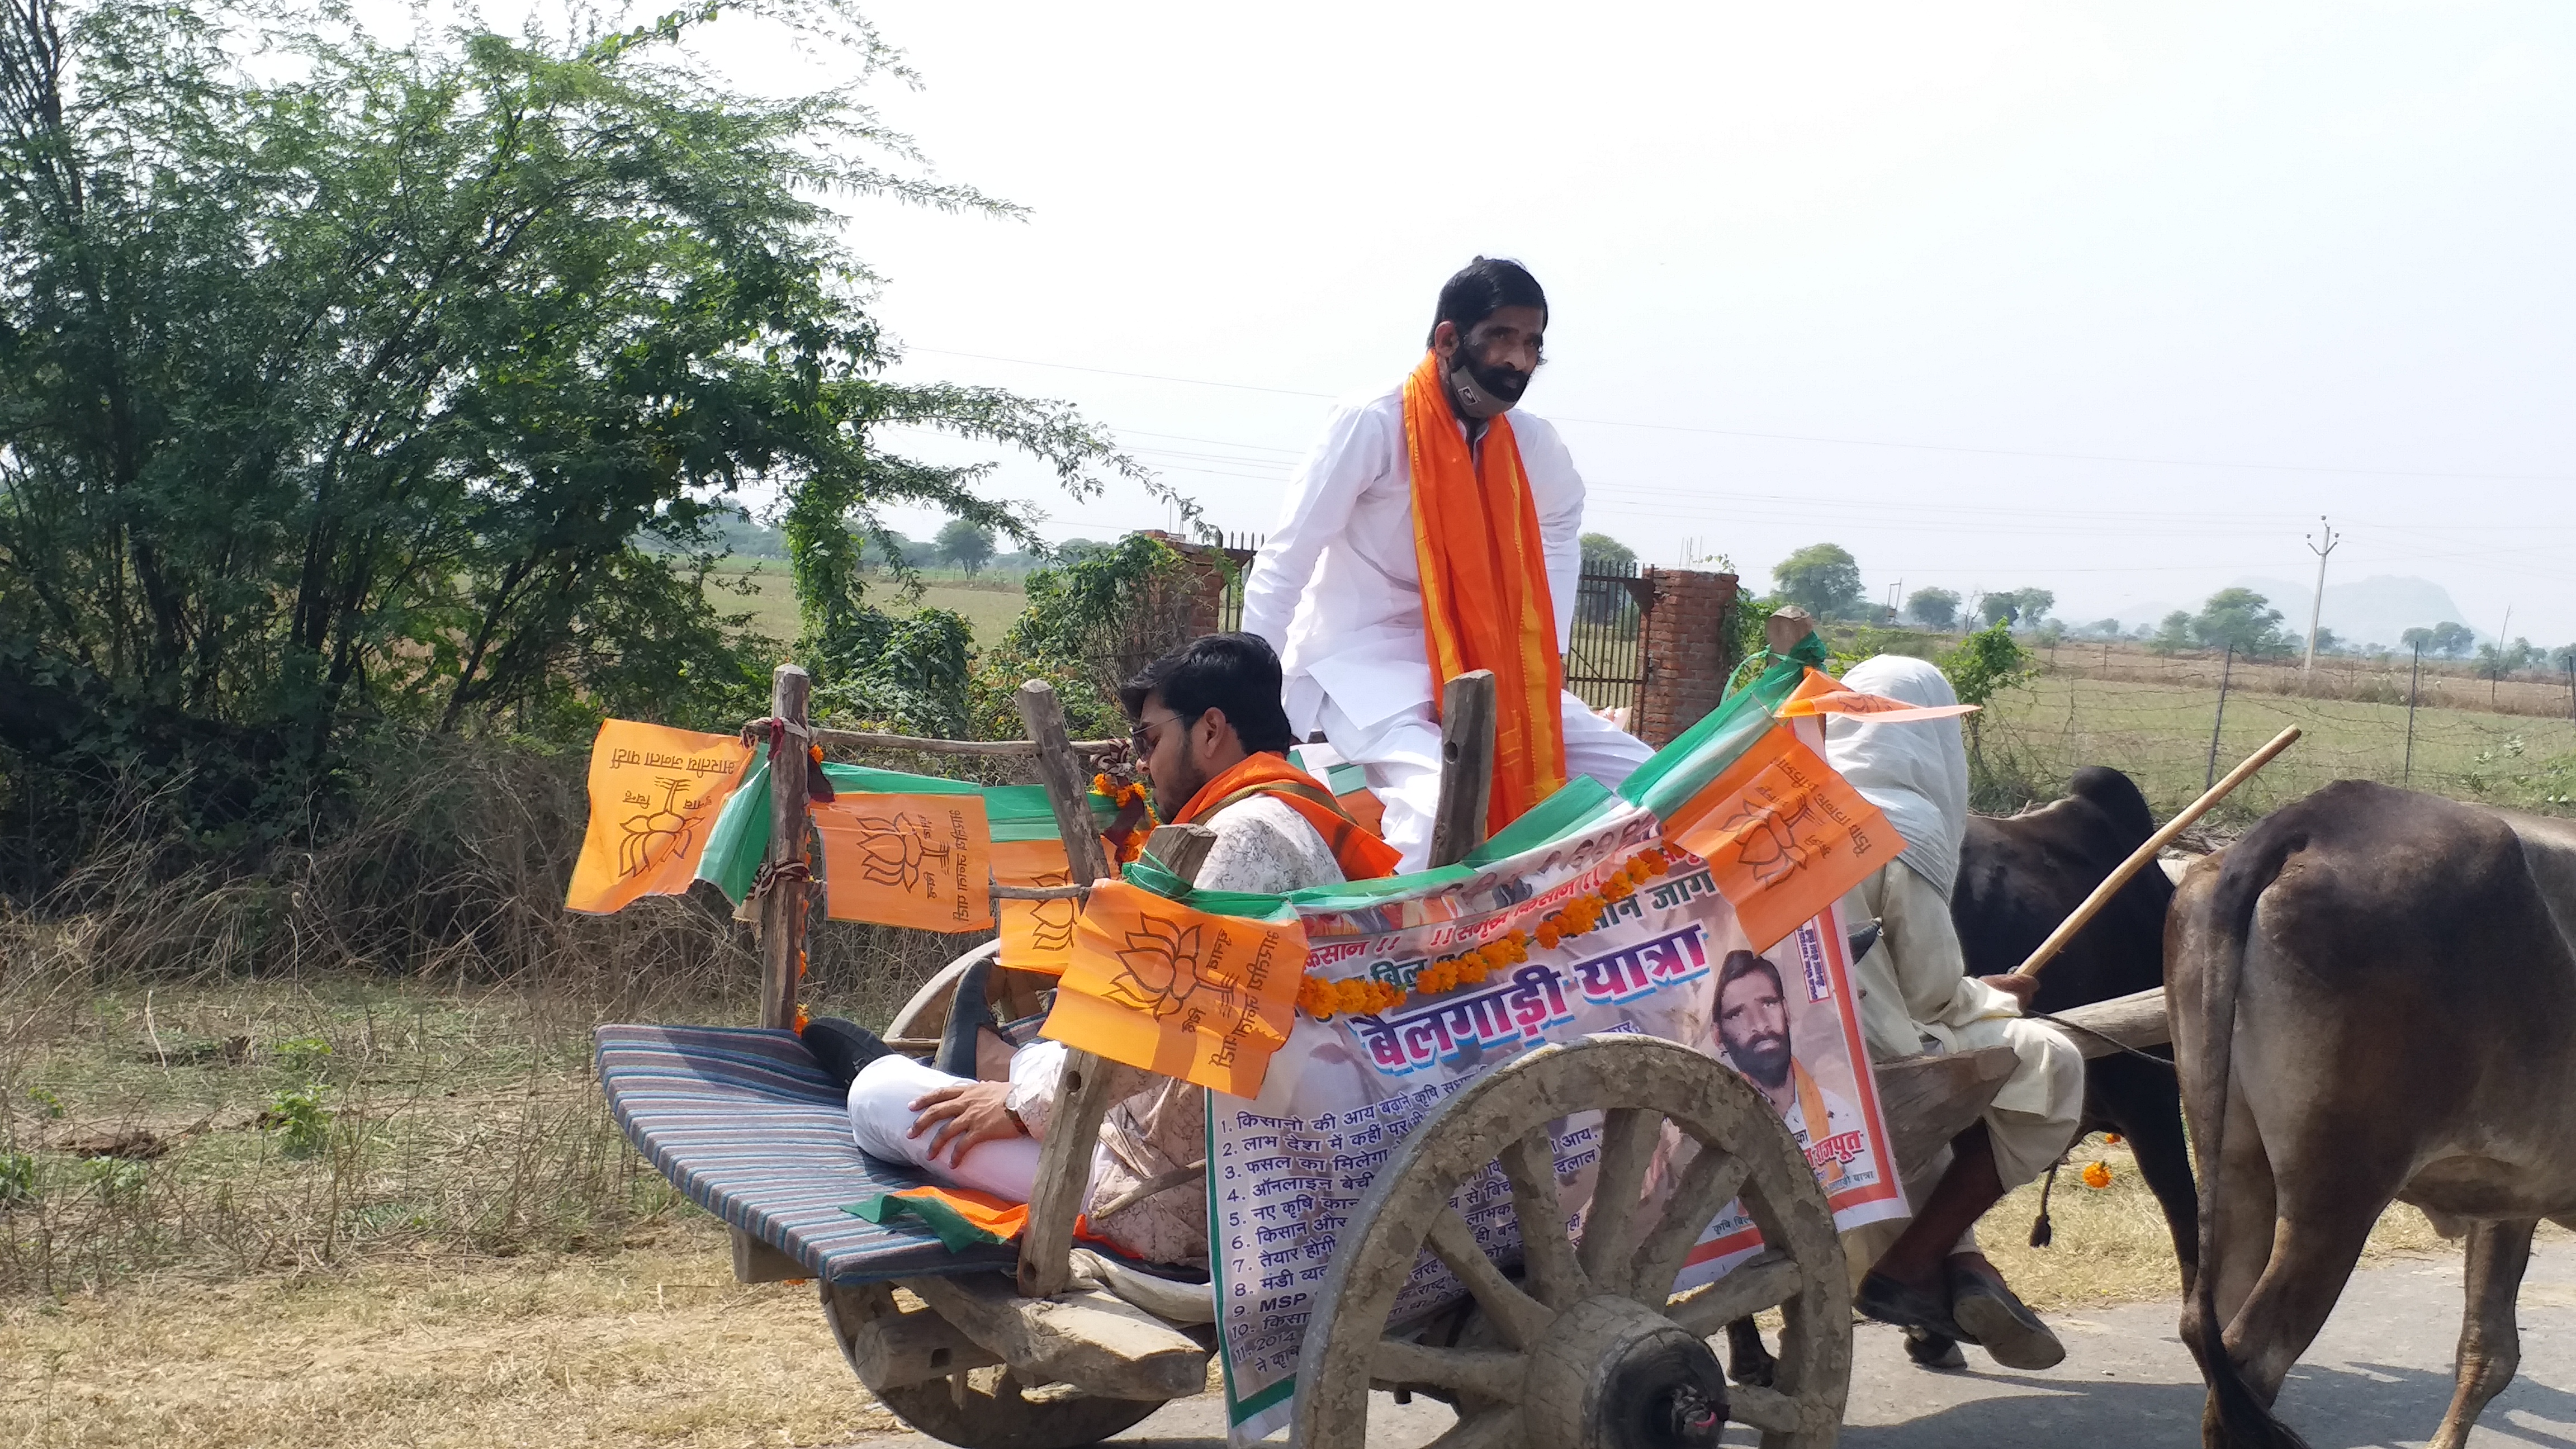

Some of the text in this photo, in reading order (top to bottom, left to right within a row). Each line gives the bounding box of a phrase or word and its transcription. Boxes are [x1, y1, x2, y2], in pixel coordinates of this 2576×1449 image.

[609, 748, 735, 778] भारतीय जनता पार्टी
[622, 789, 651, 809] चिन्ह
[1645, 871, 1716, 910] जाग
[1348, 964, 1568, 1068] बैलगाड़ी
[1574, 924, 1707, 997] यात्रा
[1221, 1083, 1439, 1134] 1. किसानो की आय बढ़ाने कृषि
[1223, 1142, 1238, 1157] 2.
[1241, 1135, 1278, 1151] लाभ
[1285, 1134, 1322, 1152] देश
[1327, 1133, 1343, 1150] में
[1349, 1123, 1381, 1146] कहीं
[1386, 1119, 1409, 1135] पर
[1224, 1150, 1388, 1180] 3. फसल का मिलेगा
[1227, 1188, 1246, 1202] 4.
[1252, 1177, 1333, 1196] ऑनलाइन
[1229, 1211, 1247, 1227] 5.
[1251, 1205, 1277, 1221] नए
[1280, 1194, 1314, 1219] कृषि
[1232, 1235, 1251, 1249] 6.
[1254, 1225, 1307, 1245] किसान
[1314, 1213, 1348, 1230] और
[1464, 1187, 1479, 1203] से
[1484, 1181, 1513, 1200] बिच
[1232, 1258, 1252, 1273] 7.
[1258, 1249, 1299, 1267] तैयार
[1464, 1202, 1512, 1225] लाभक
[1234, 1282, 1253, 1296] 8.
[1259, 1268, 1294, 1290] मंडी
[1474, 1226, 1491, 1244] ही
[1259, 1292, 1308, 1313] MSP
[1232, 1323, 1255, 1339] 10.
[1262, 1311, 1312, 1330] किसा
[1256, 1332, 1296, 1351] 2014
[1255, 1357, 1268, 1372] ने
